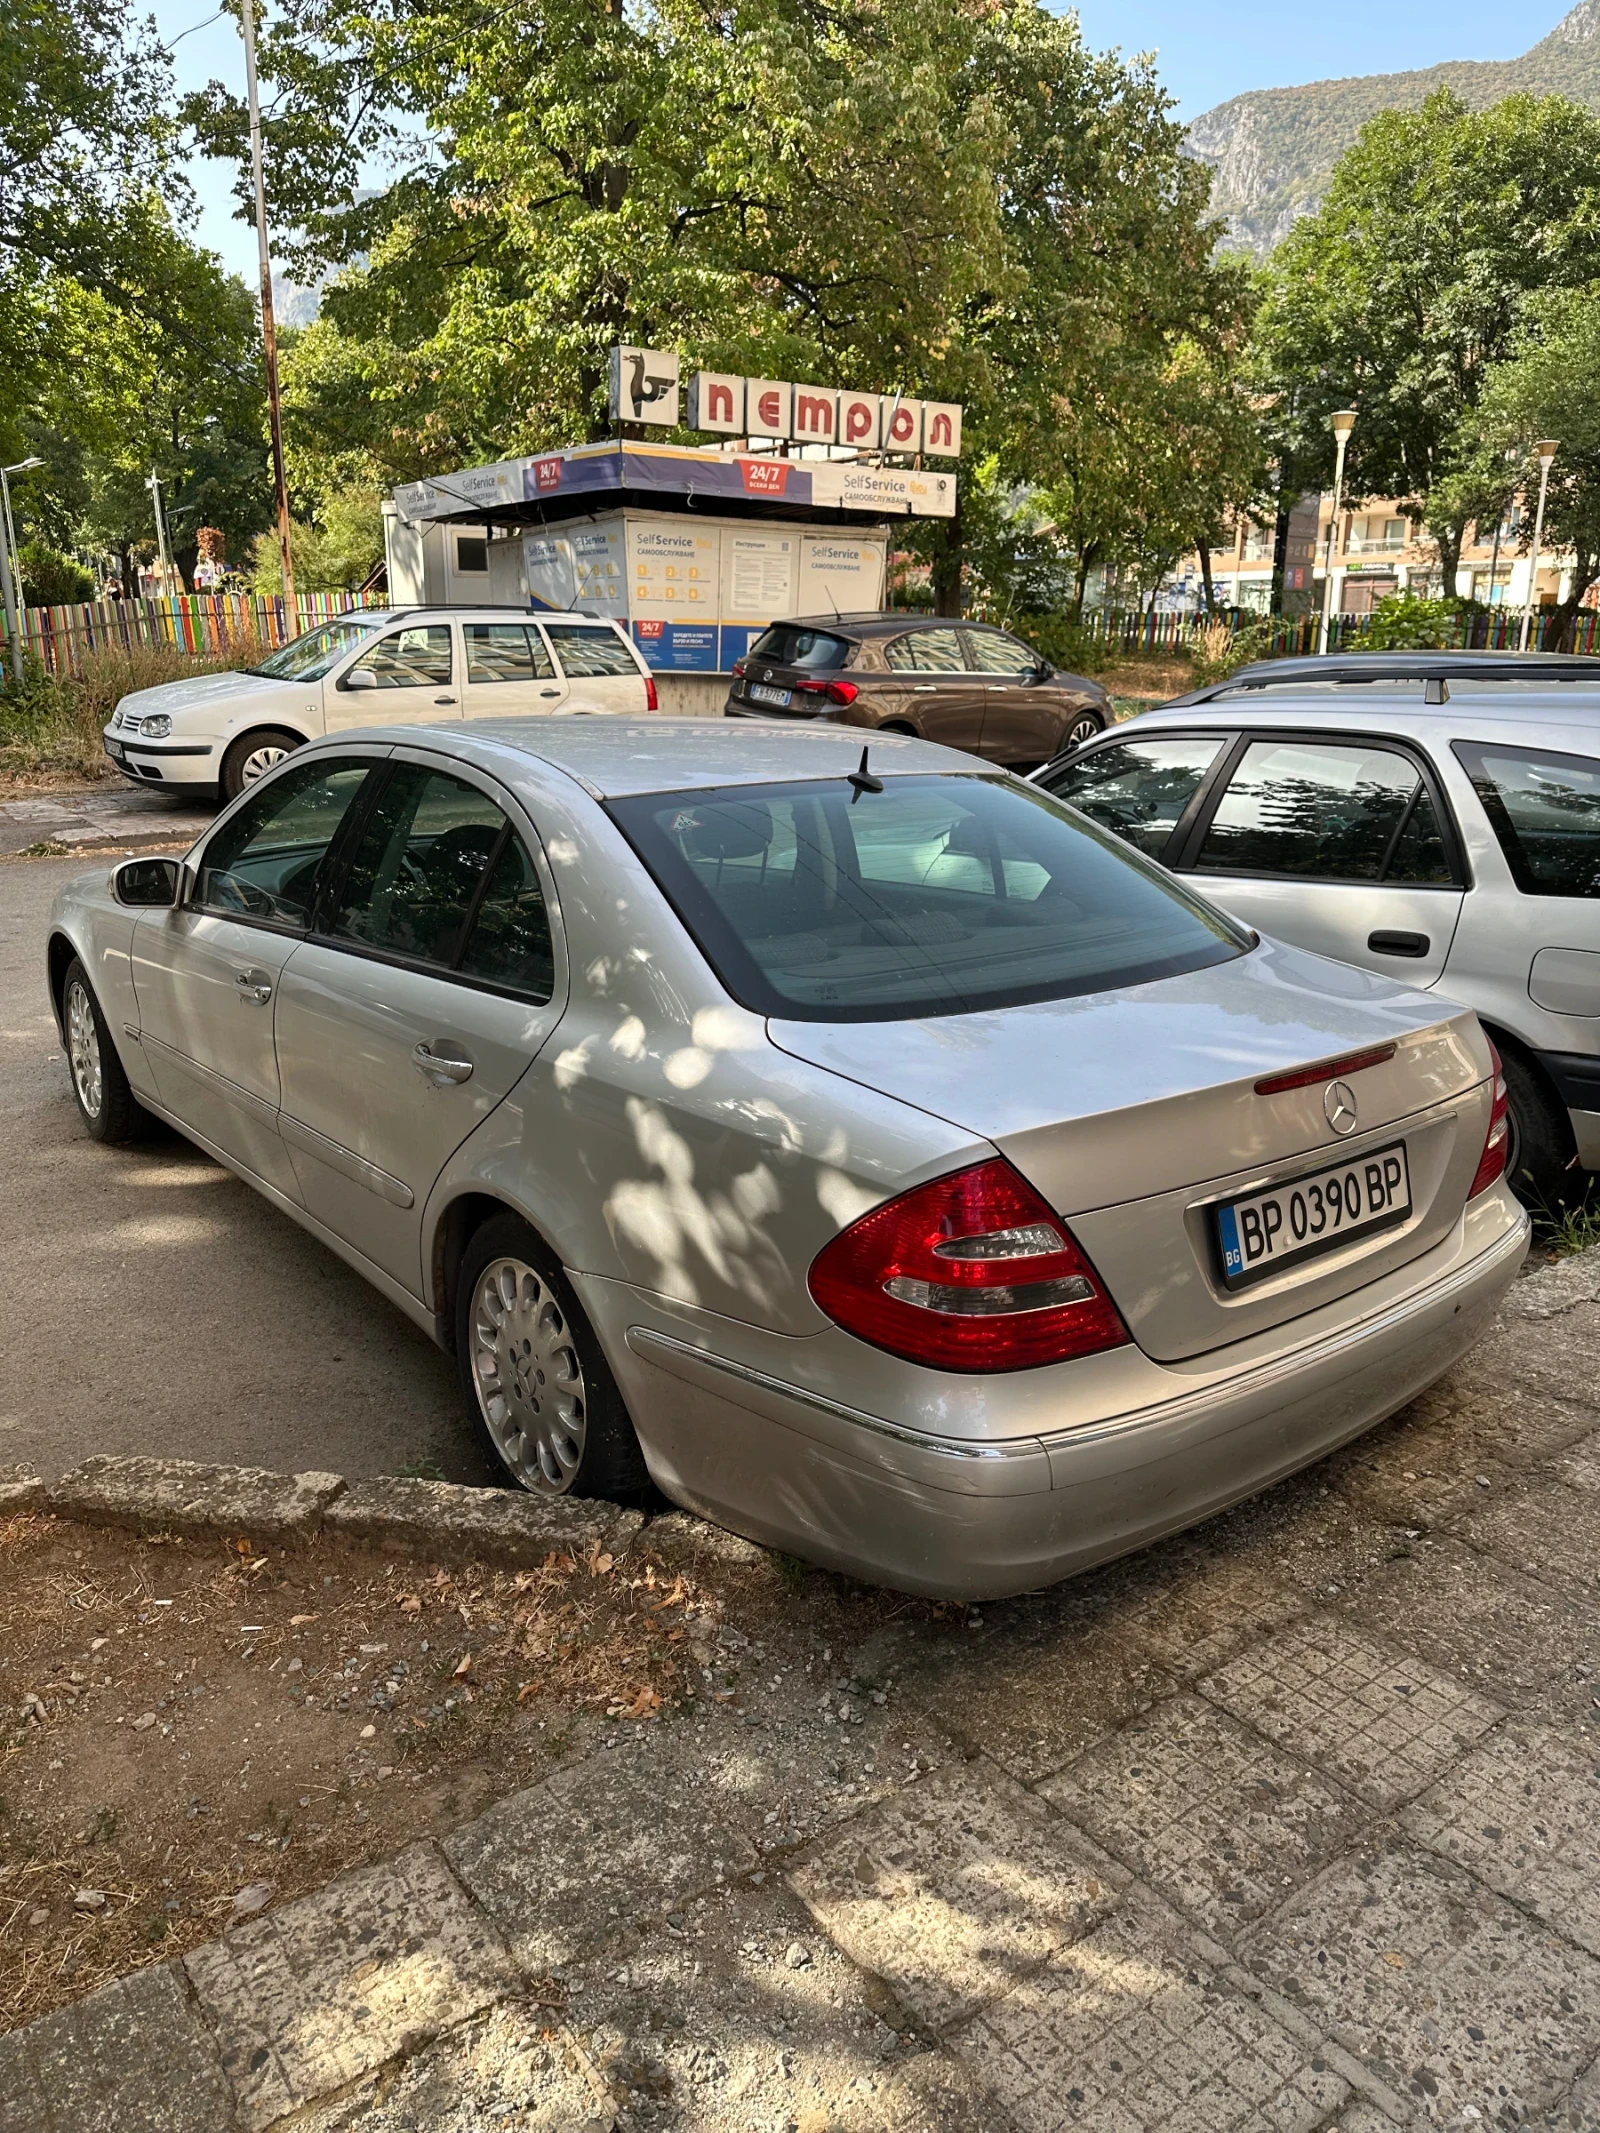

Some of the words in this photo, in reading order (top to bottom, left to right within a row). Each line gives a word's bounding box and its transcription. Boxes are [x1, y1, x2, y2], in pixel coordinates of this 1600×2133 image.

[540, 462, 556, 478] 24/7
[749, 464, 780, 482] 24/7
[462, 475, 495, 493] SelfService
[749, 481, 768, 489] ВСЕКИ
[844, 474, 906, 492] SelfService
[844, 492, 909, 505] САМООБСЛУЖВАНЕ
[637, 533, 693, 546] SelfService
[637, 548, 695, 558] САМООБСЛУЖВАНЕ
[811, 546, 859, 559] SelfService
[811, 562, 861, 572] САМООБСЛУЖВАНЕ
[641, 622, 660, 632] 24/7
[1240, 1200, 1283, 1262] BP
[1290, 1172, 1361, 1241] 0390
[1364, 1156, 1402, 1213] BP
[1225, 1248, 1241, 1267] BG
